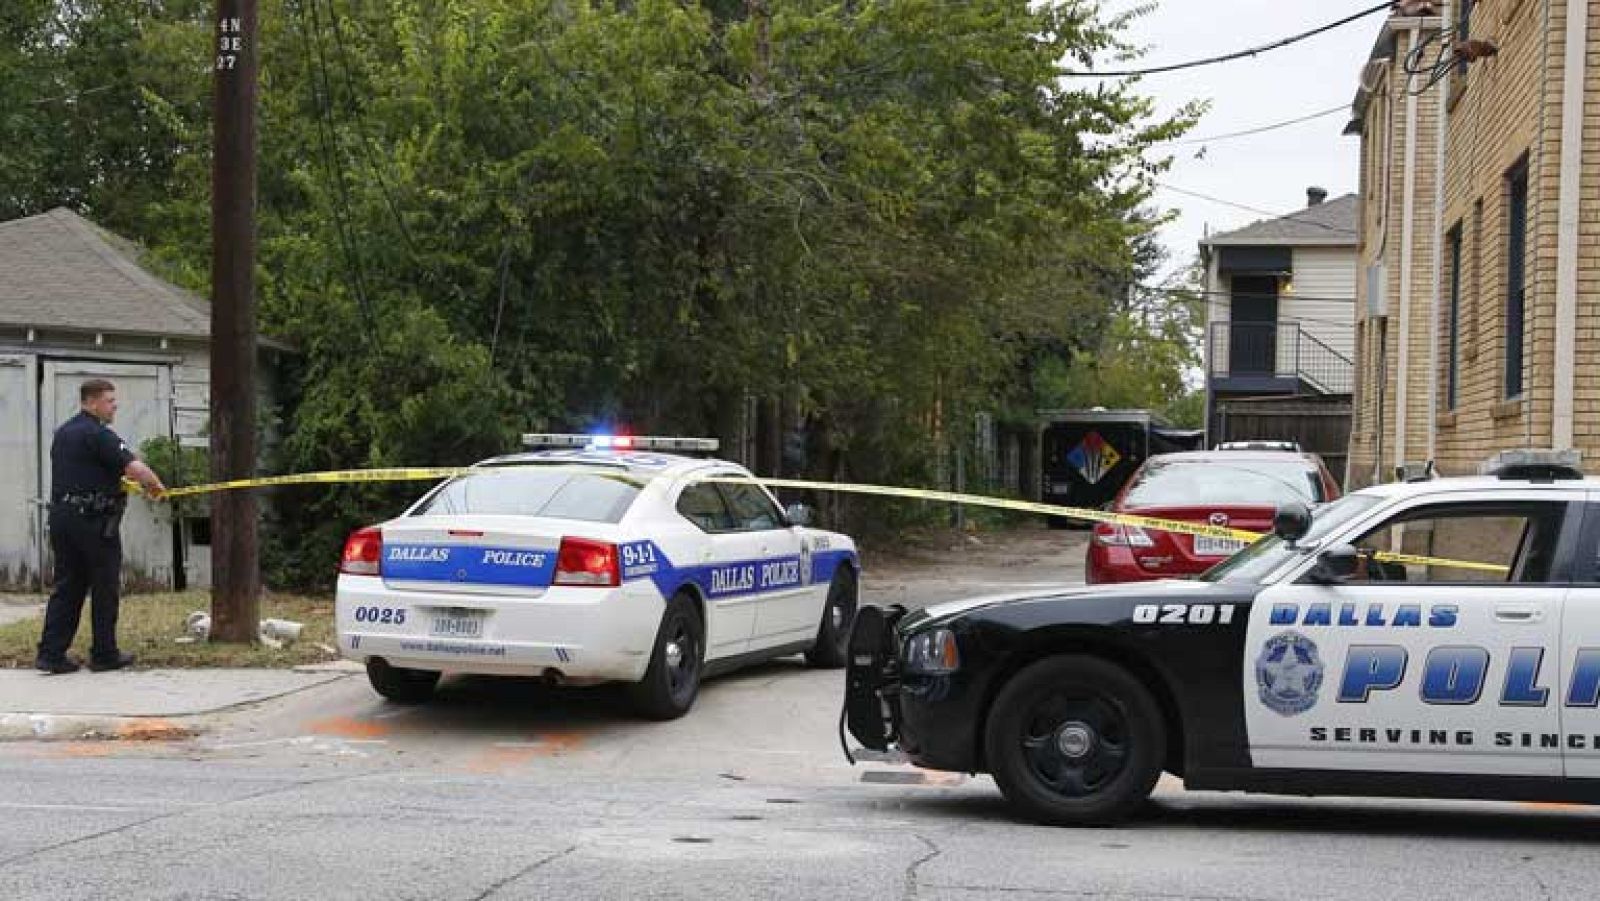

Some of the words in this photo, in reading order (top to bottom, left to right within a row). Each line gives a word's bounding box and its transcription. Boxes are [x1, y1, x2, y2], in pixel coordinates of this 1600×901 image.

[388, 547, 449, 561] DALLAS
[482, 550, 546, 567] POLICE
[623, 543, 655, 565] 9-1-1
[711, 566, 754, 594] DALLAS
[761, 560, 800, 588] POLICE
[354, 606, 406, 625] 0025
[1132, 604, 1234, 625] 0201
[1270, 604, 1459, 626] DALLAS
[1310, 728, 1474, 745] SERVING
